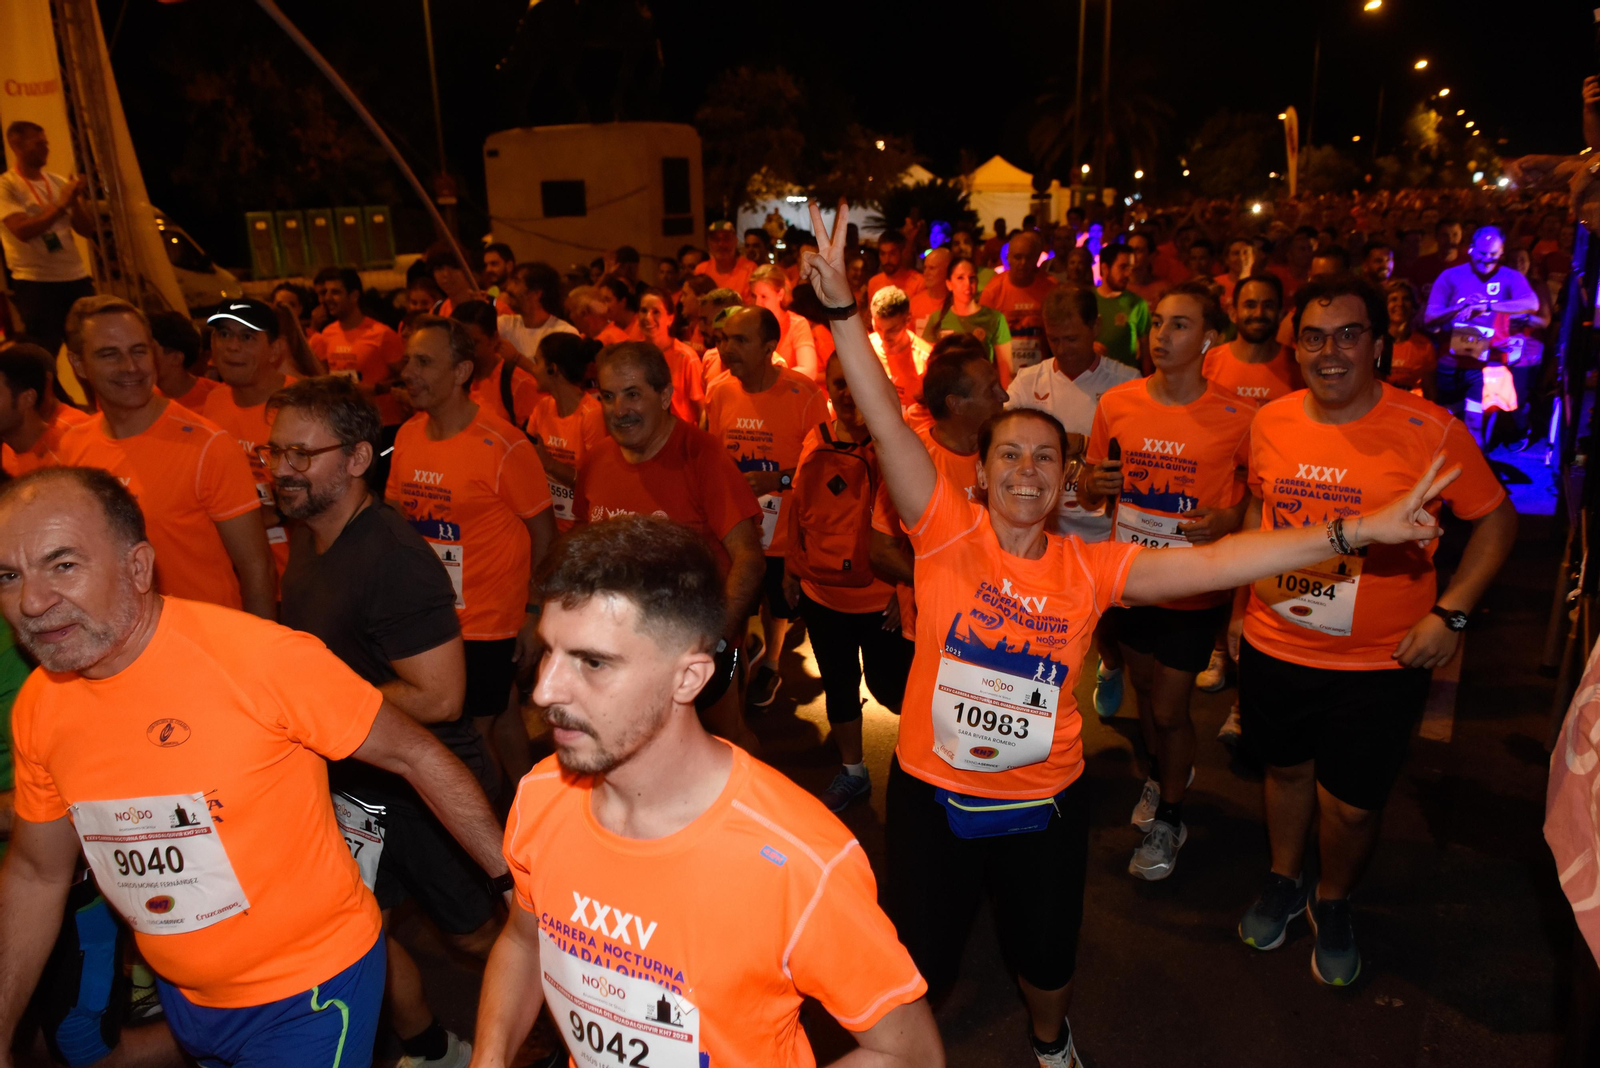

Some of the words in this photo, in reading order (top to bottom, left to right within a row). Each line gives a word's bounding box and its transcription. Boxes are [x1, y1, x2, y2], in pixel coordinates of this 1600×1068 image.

[1236, 386, 1270, 398] XXXV
[736, 417, 764, 430] XXXV
[1142, 437, 1186, 456] XXXV
[1125, 450, 1157, 460] CARRERA
[1159, 455, 1198, 466] NOCTURNA
[1129, 457, 1197, 474] GUADALQUIVIR
[413, 469, 444, 485] XXXV
[1295, 463, 1348, 484] XXXV
[1275, 478, 1312, 488] CARRERA
[1315, 483, 1363, 495] NOCTURNA
[1278, 486, 1362, 505] GUADALQUIVIR
[1275, 573, 1336, 601] 10984
[982, 593, 1069, 634] GUADALQUIVIR
[952, 690, 970, 698] CARRERA
[1000, 702, 1030, 712] GUADALQUIVIR
[954, 702, 1030, 739] 10983
[958, 729, 972, 738] SARA
[973, 732, 992, 742] RIVERA
[992, 737, 1017, 747] ROMERO
[148, 831, 183, 840] GUADALQUIVIR
[113, 845, 185, 876] 9040
[117, 881, 138, 889] CARLOS
[160, 877, 199, 888] FERNÁNDEZ
[195, 901, 239, 922] Cruzcampo
[569, 890, 659, 951] XXXV
[541, 912, 597, 949] CARRERA
[603, 941, 685, 984] NOCTURNA
[574, 998, 603, 1015] NOCTURNA
[603, 1010, 613, 1020] DEL
[613, 1015, 659, 1035] GUADALQUIVIR
[658, 1028, 672, 1038] KH7
[671, 1031, 689, 1041] 2023
[569, 1010, 650, 1068] 9042
